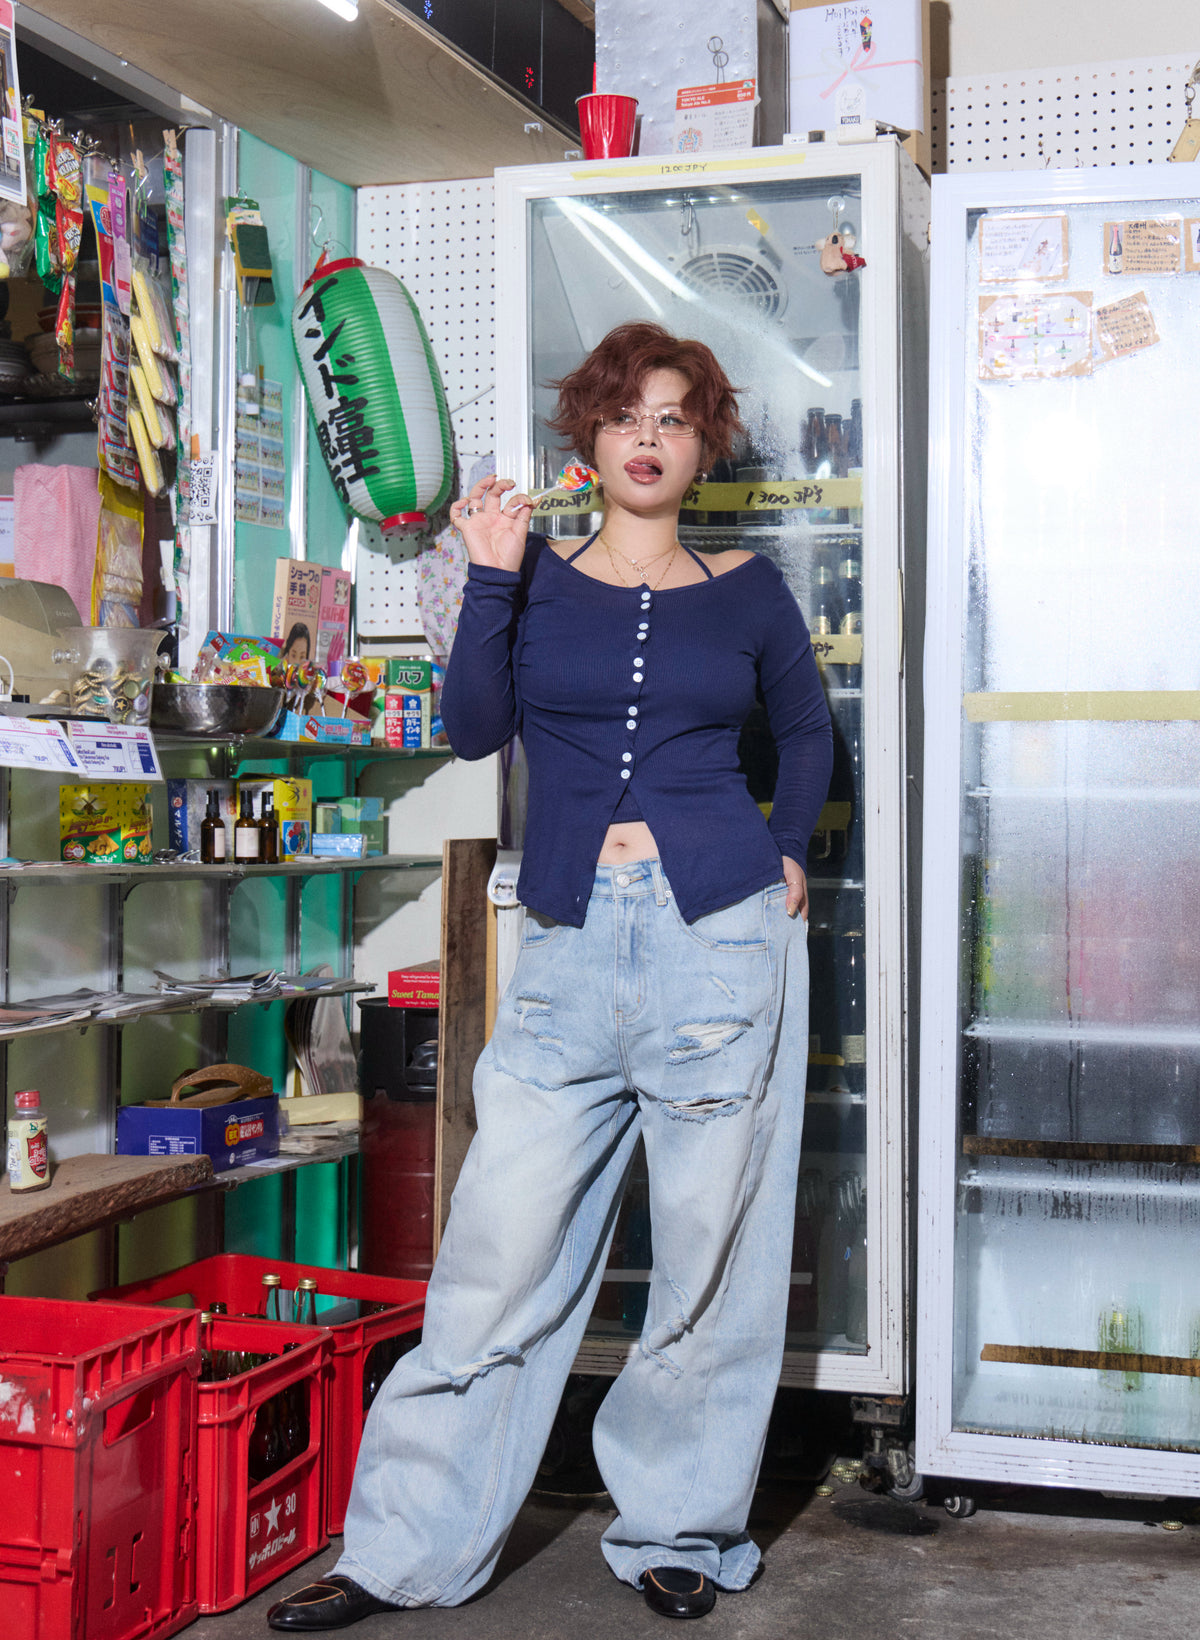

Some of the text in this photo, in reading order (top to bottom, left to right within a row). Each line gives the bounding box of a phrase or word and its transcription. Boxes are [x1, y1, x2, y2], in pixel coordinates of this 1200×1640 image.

[290, 566, 320, 584] ショーワの
[386, 718, 402, 726] カラー
[406, 718, 421, 726] カラー
[386, 726, 402, 734] インキ
[405, 726, 421, 734] インキ
[392, 989, 414, 999] Sweet
[285, 1492, 297, 1517] 30
[248, 1527, 297, 1569] サッポロビール
